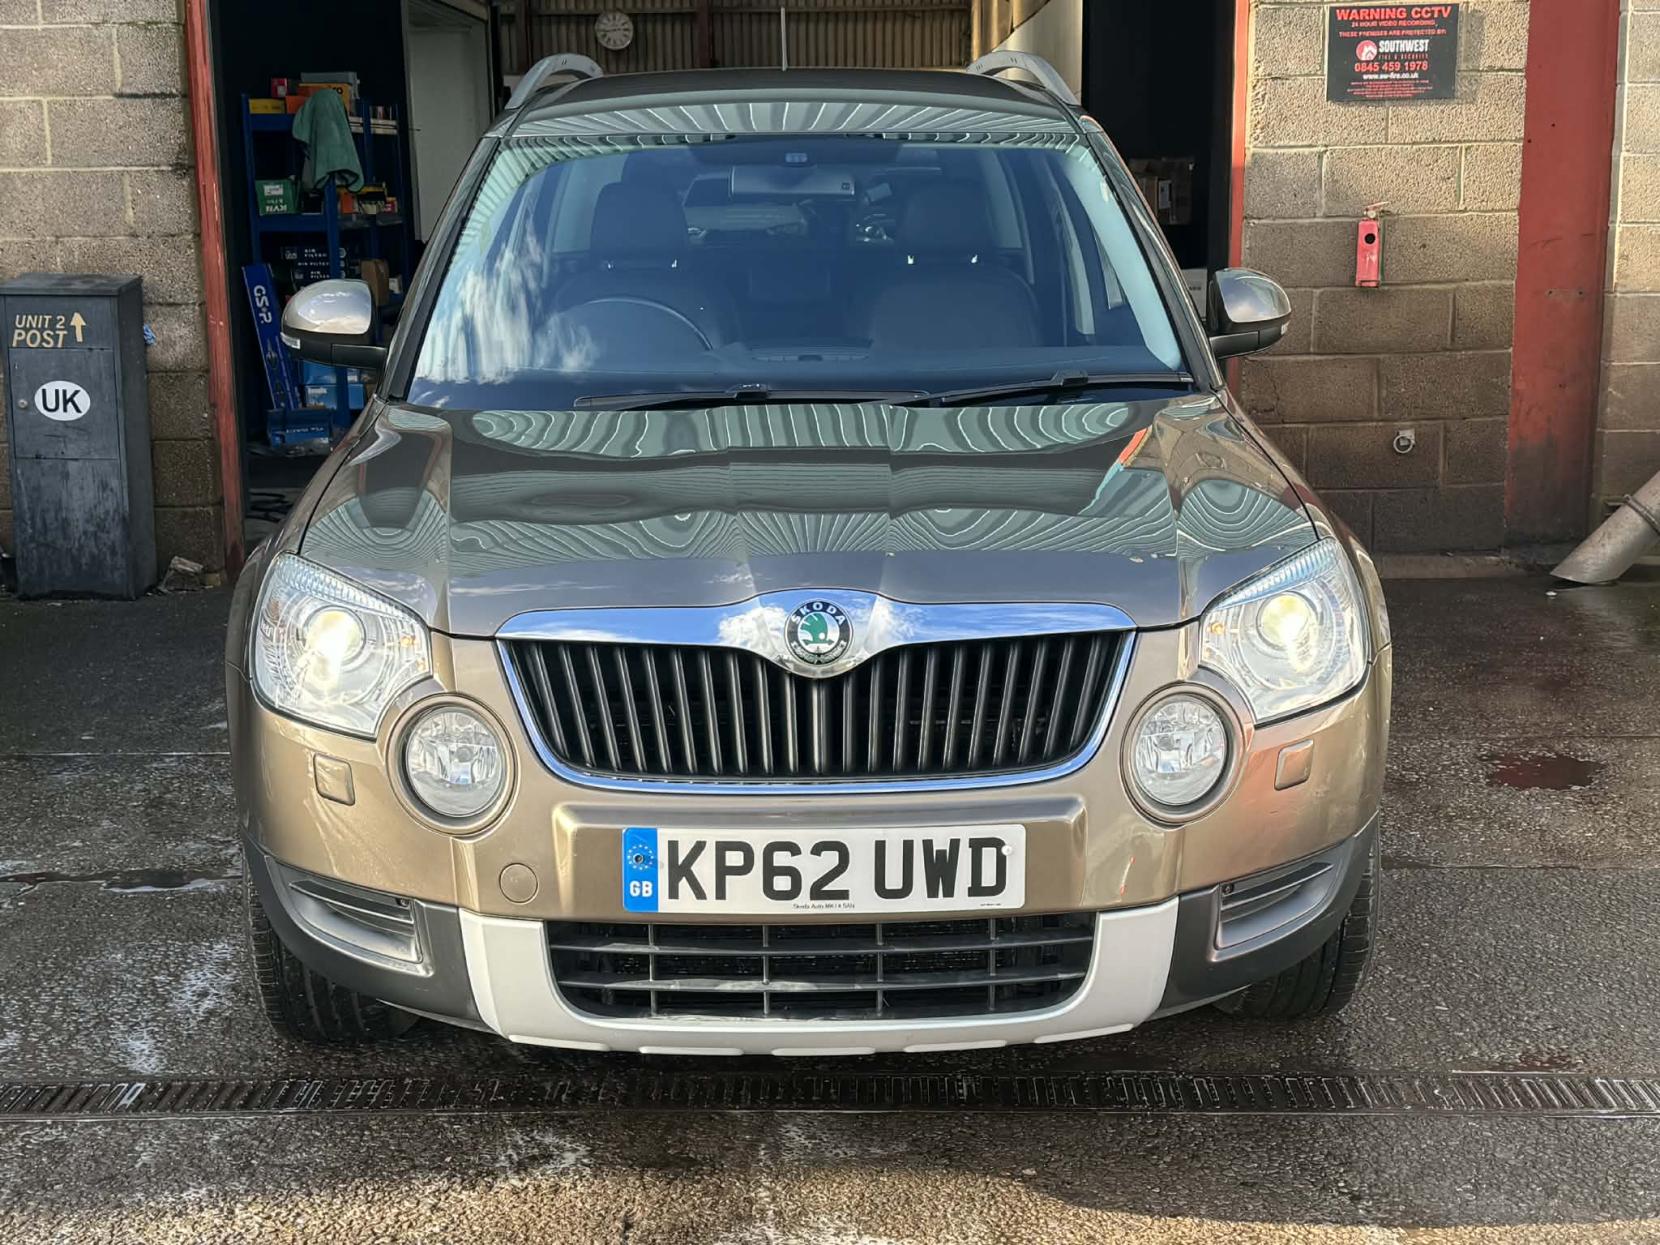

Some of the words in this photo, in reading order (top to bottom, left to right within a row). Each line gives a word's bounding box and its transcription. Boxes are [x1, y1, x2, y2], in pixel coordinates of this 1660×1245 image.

[1336, 8, 1407, 20] WARNING
[1411, 6, 1452, 18] CCTV
[1379, 39, 1430, 53] SOUTHWEST
[1354, 61, 1380, 73] 0845
[1382, 61, 1401, 72] 459
[1404, 60, 1428, 71] 1978
[15, 314, 52, 328] UNIT
[56, 315, 65, 329] 2
[12, 329, 68, 348] POST
[41, 388, 82, 413] UK
[667, 839, 850, 900] KP62
[874, 836, 1008, 899] UWD
[629, 880, 653, 897] GB
